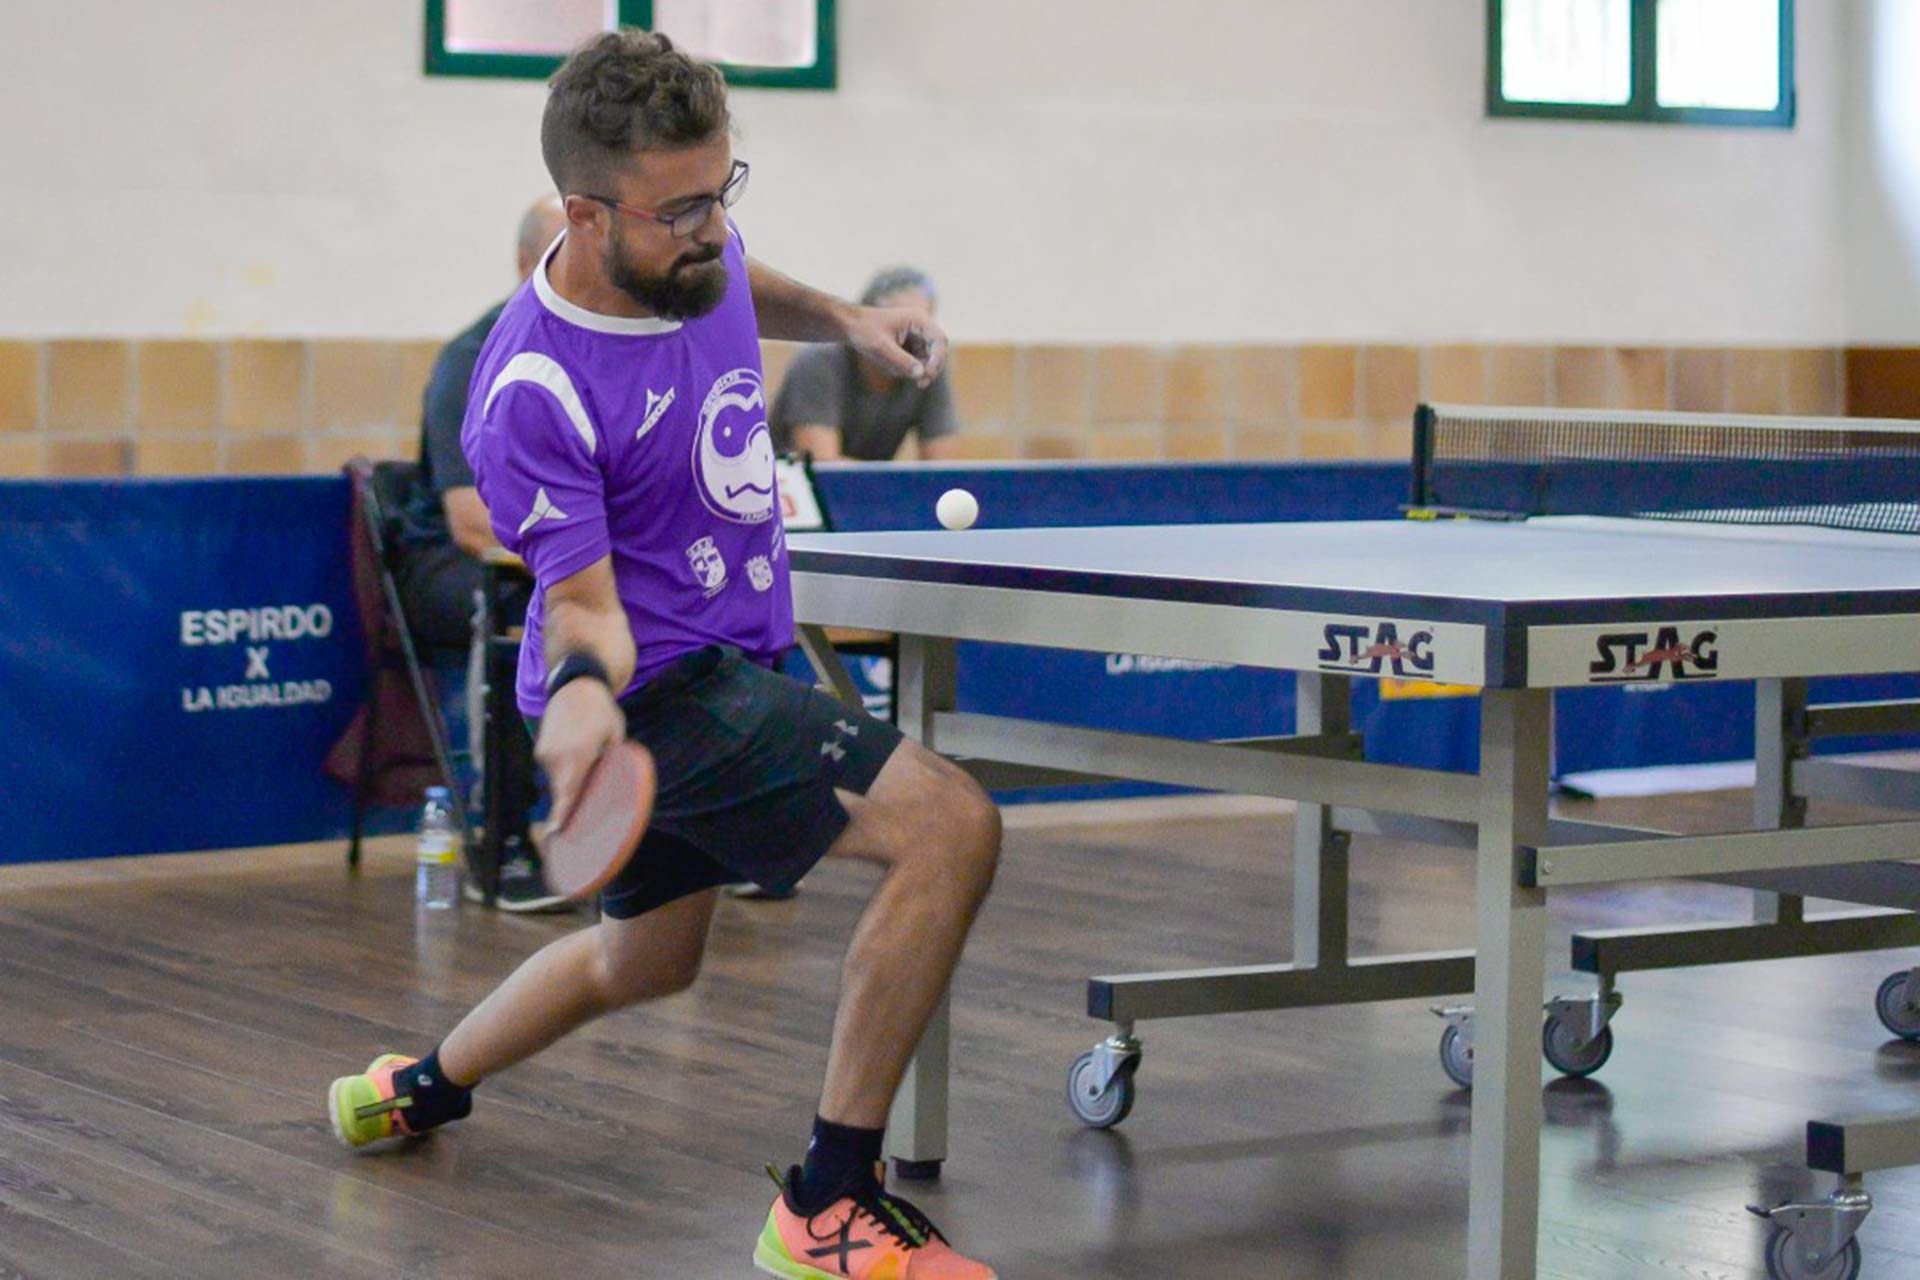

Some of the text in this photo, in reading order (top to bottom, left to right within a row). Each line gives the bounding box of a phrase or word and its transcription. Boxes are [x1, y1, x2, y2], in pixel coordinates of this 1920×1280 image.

[180, 604, 333, 645] ESPIRDO
[245, 646, 270, 679] X
[1318, 622, 1435, 678] STAG
[1589, 626, 1718, 681] STAG
[182, 679, 332, 712] LA IGUALDAD
